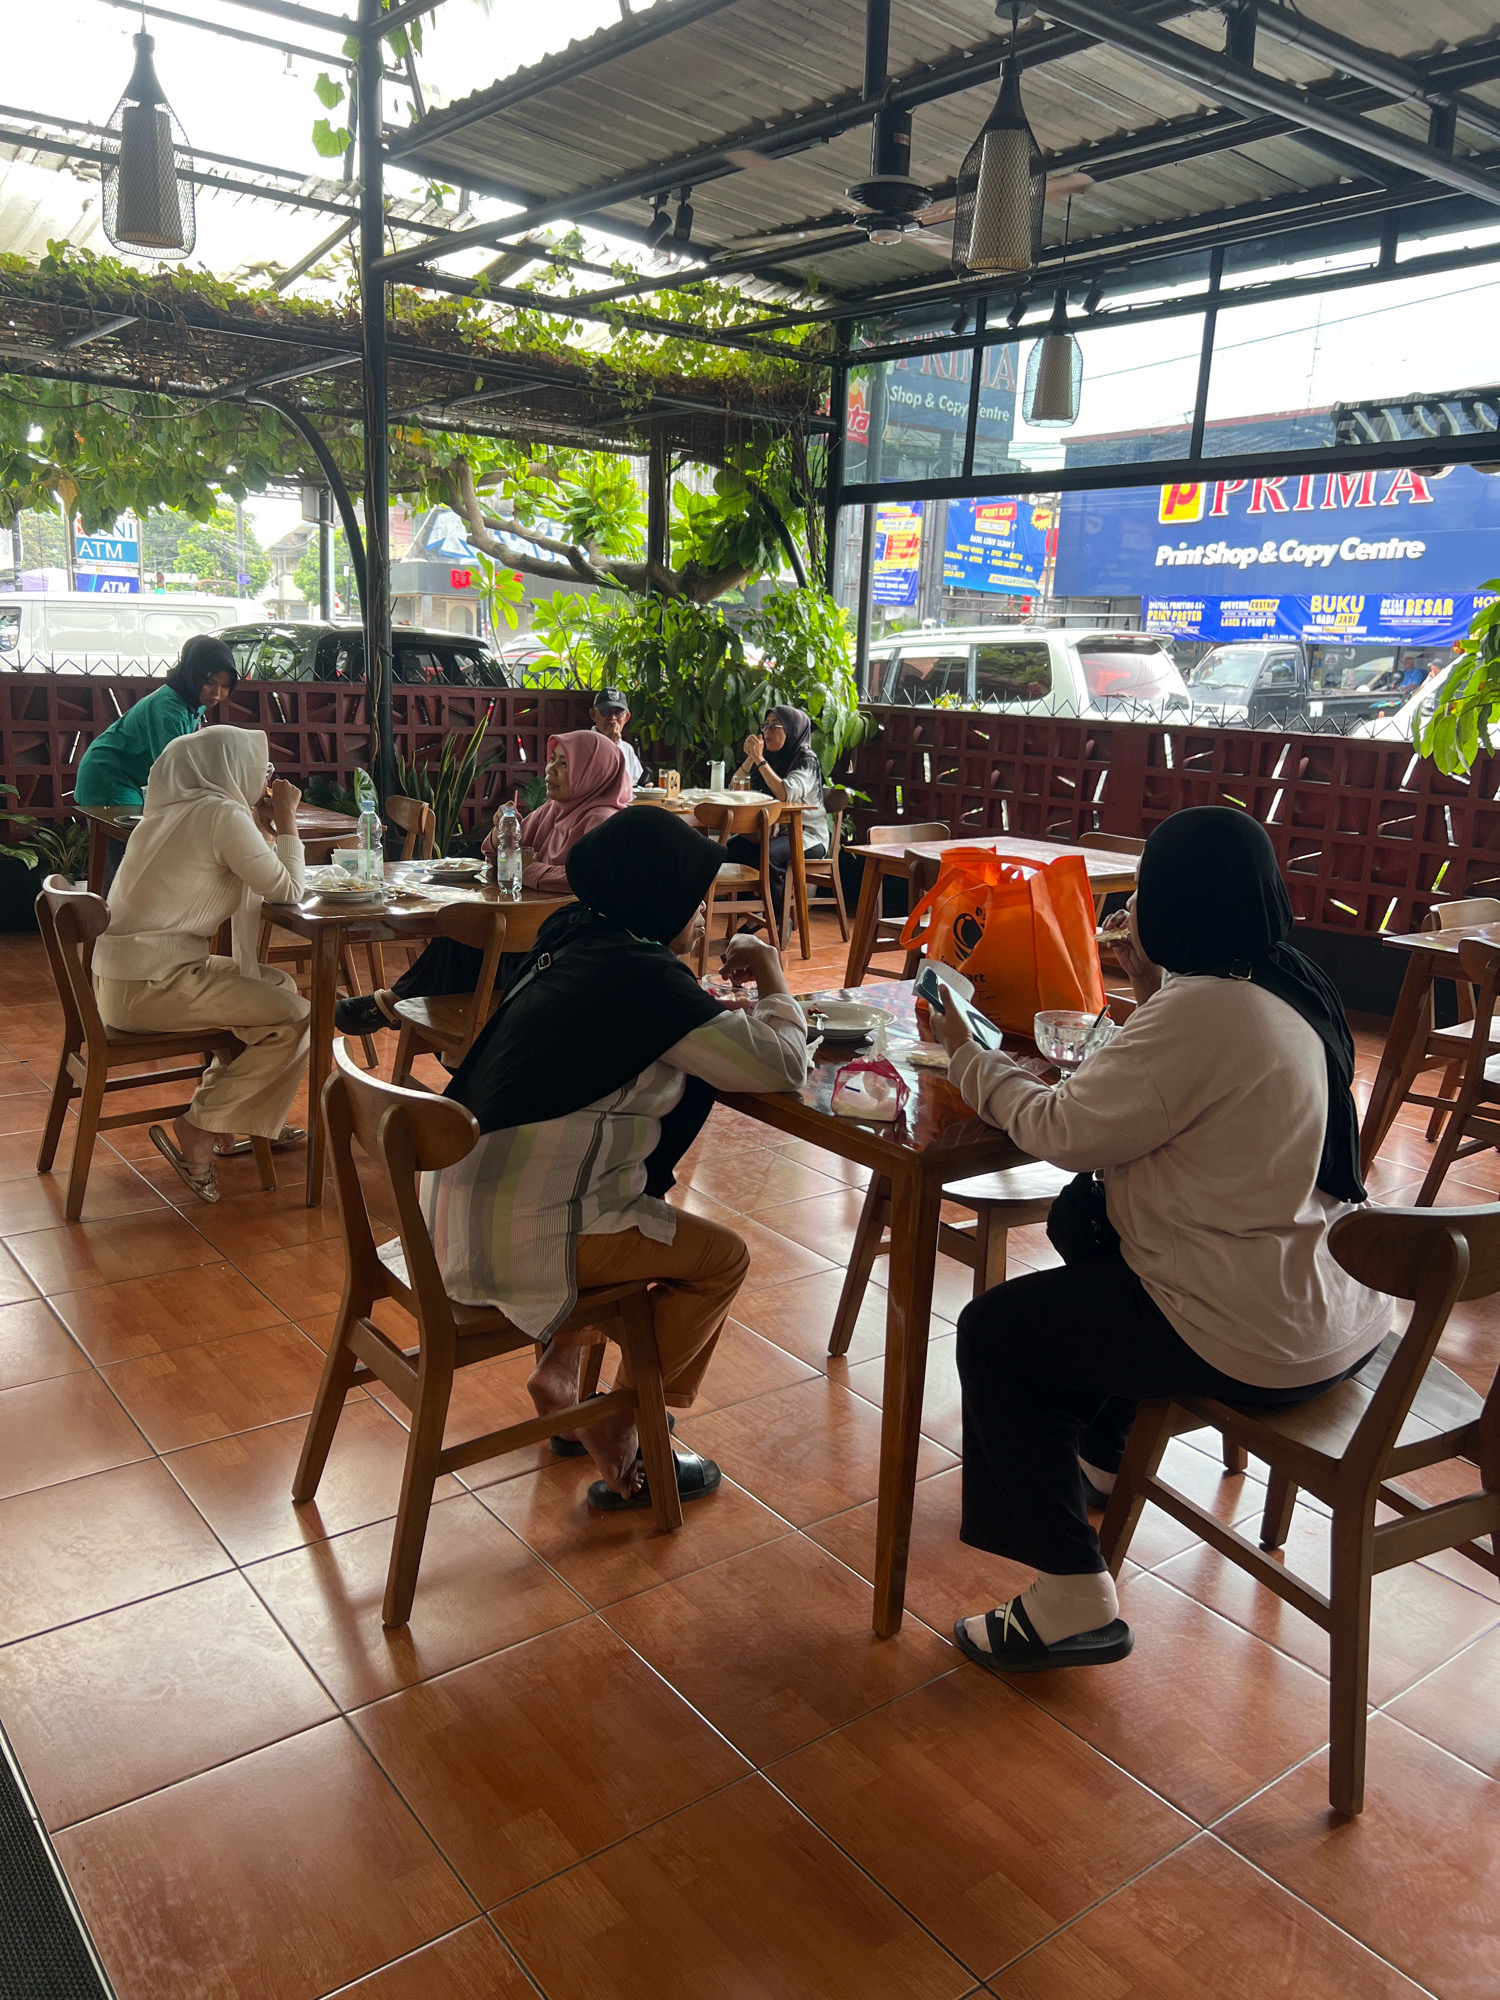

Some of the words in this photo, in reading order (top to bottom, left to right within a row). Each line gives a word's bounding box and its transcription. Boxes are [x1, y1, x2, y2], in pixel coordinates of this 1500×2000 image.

[889, 385, 922, 408] Shop
[925, 392, 936, 408] &
[939, 395, 969, 418] Copy
[977, 402, 1010, 422] entre
[1209, 469, 1434, 516] PRIMA
[79, 541, 123, 559] ATM
[1279, 539, 1340, 567] Copy
[1339, 537, 1426, 561] Centre
[101, 581, 130, 593] ATM
[1311, 595, 1365, 613] BUKU
[1405, 599, 1453, 616] BESAR
[1171, 611, 1202, 621] POSTER
[1338, 615, 1356, 624] JADI
